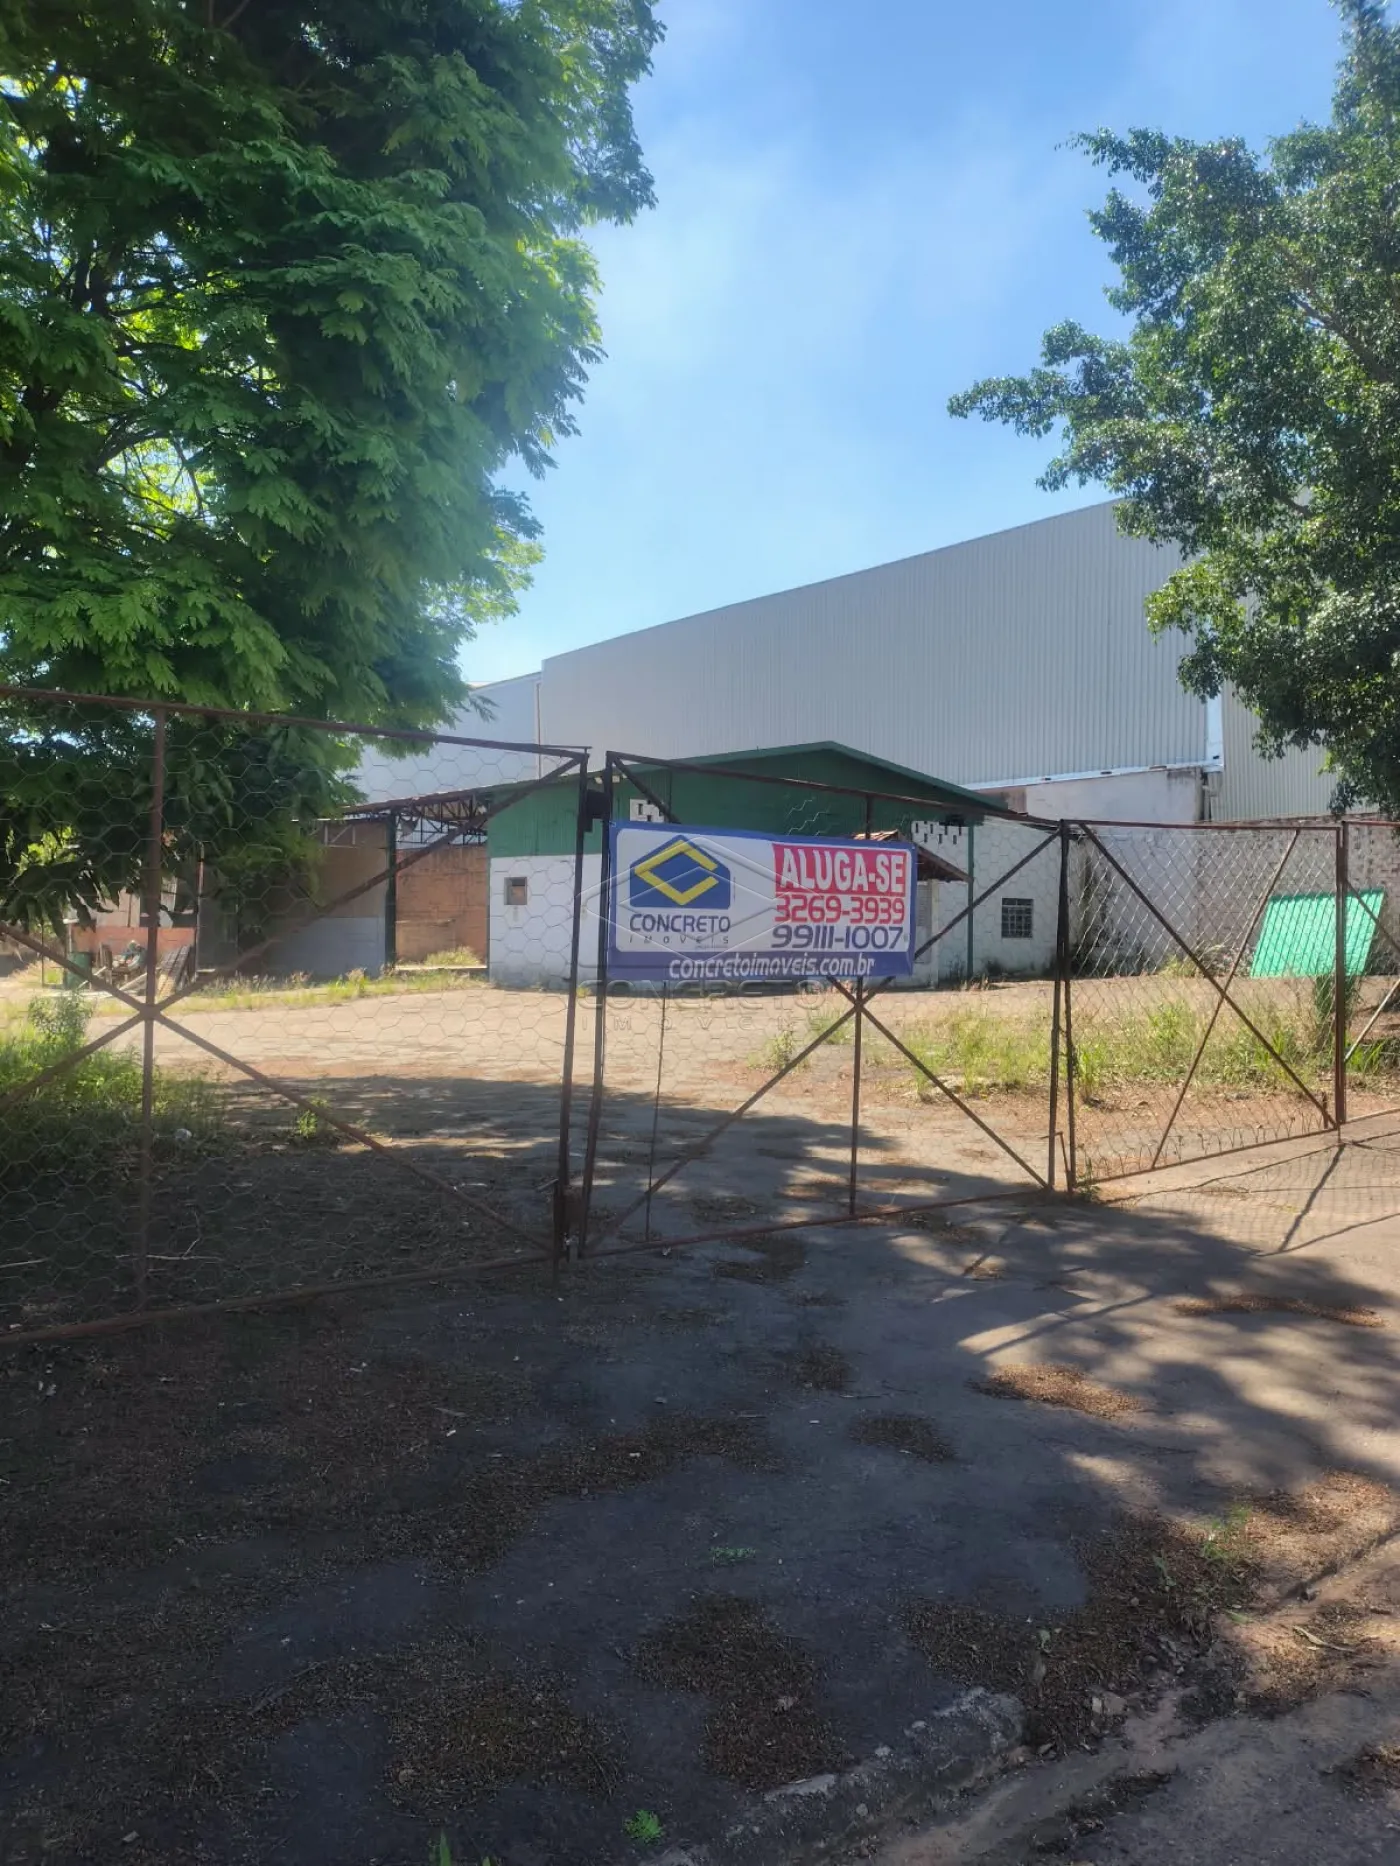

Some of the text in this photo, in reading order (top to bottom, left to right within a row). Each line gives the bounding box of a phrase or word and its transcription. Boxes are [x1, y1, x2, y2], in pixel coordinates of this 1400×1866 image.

[781, 847, 904, 893] ALUGA-SE
[775, 894, 905, 924] 3269-3939
[630, 912, 731, 932] CONCRETO
[771, 924, 903, 949] 99111-1007
[669, 952, 875, 977] concretoimoveis.com.br
